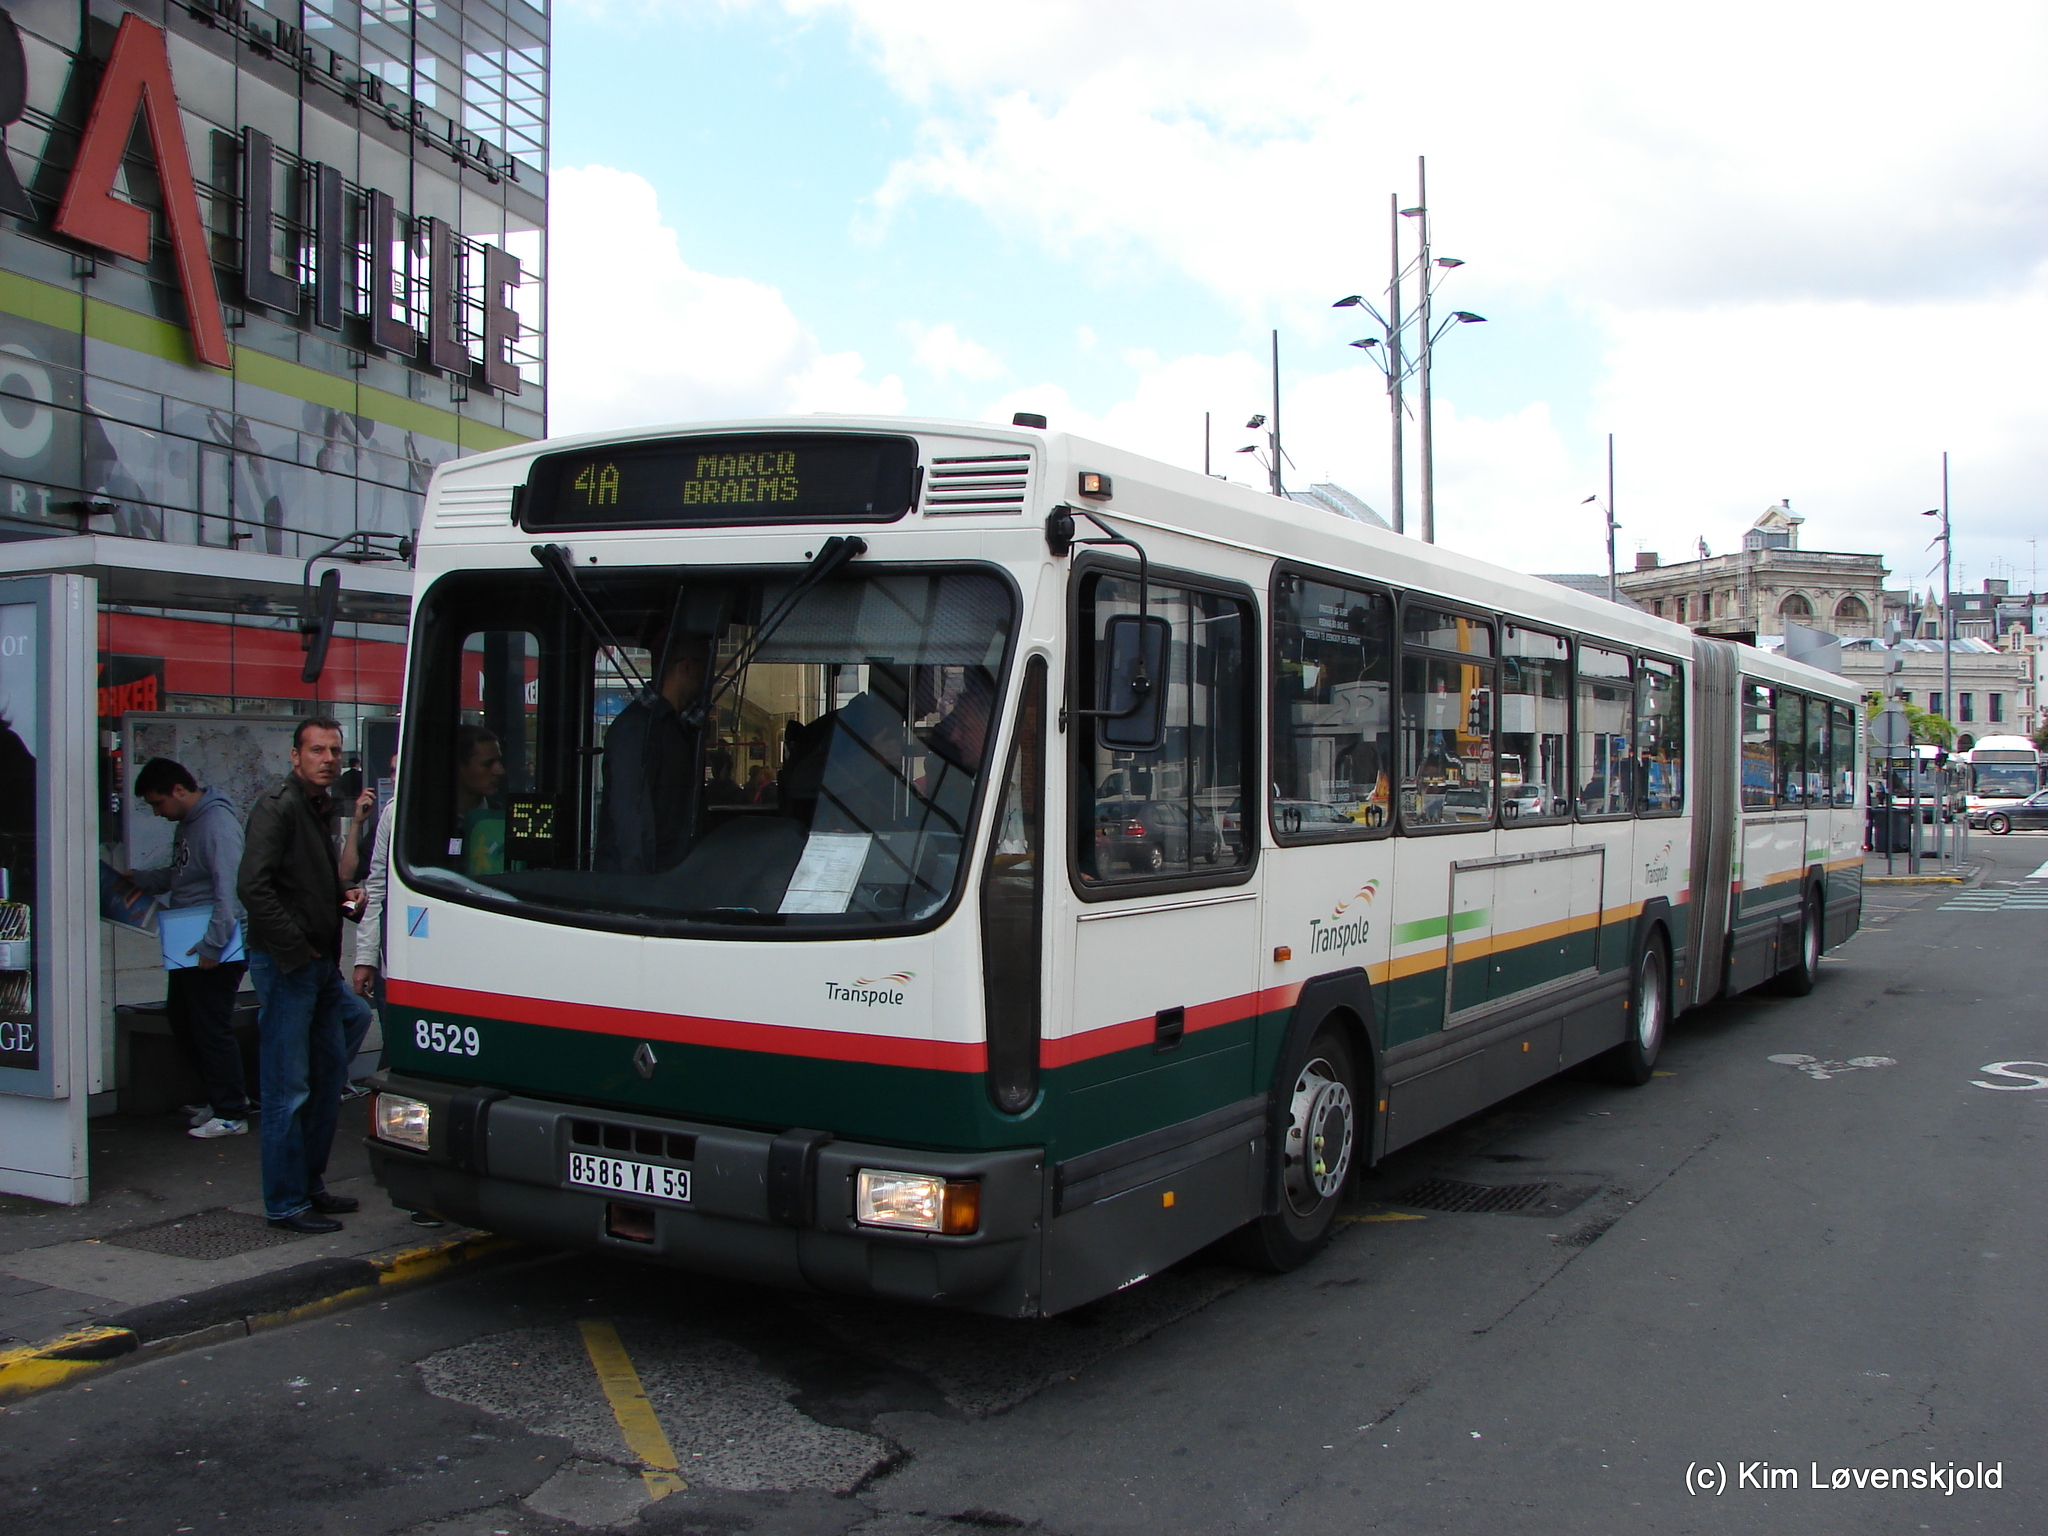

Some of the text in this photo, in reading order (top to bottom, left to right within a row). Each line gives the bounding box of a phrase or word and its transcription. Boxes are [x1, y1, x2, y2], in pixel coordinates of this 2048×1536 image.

[697, 451, 796, 477] MARCQ
[574, 462, 620, 505] 4A
[683, 476, 799, 504] BRAEMS
[513, 803, 554, 838] 52
[1310, 915, 1369, 957] Transpole
[826, 982, 904, 1007] Transpole
[0, 1021, 35, 1052] GE
[415, 1019, 480, 1056] 8529
[572, 1155, 688, 1198] 8586 YA 59
